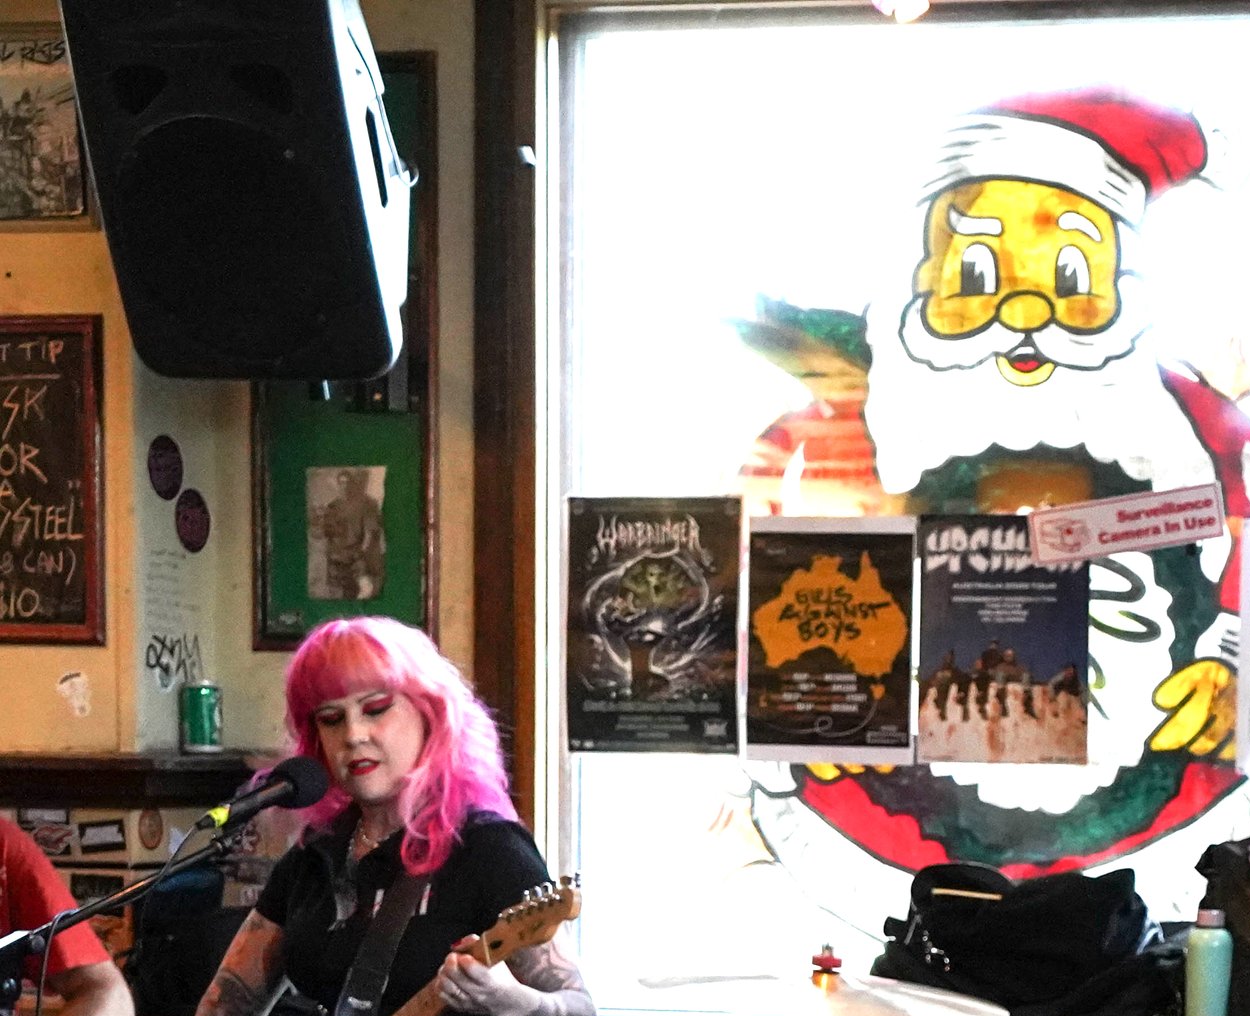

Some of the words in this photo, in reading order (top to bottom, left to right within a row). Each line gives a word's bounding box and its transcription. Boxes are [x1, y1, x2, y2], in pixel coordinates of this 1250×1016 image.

[17, 339, 64, 364] TIP
[0, 441, 48, 484] OR
[1116, 498, 1214, 524] Surveillance
[1098, 524, 1161, 545] Camera
[1164, 520, 1181, 533] In
[1183, 515, 1217, 531] Use
[22, 547, 76, 585] CAN)
[795, 586, 853, 605] GIRLS
[778, 601, 891, 623] AGAINST
[797, 620, 862, 644] BOYS
